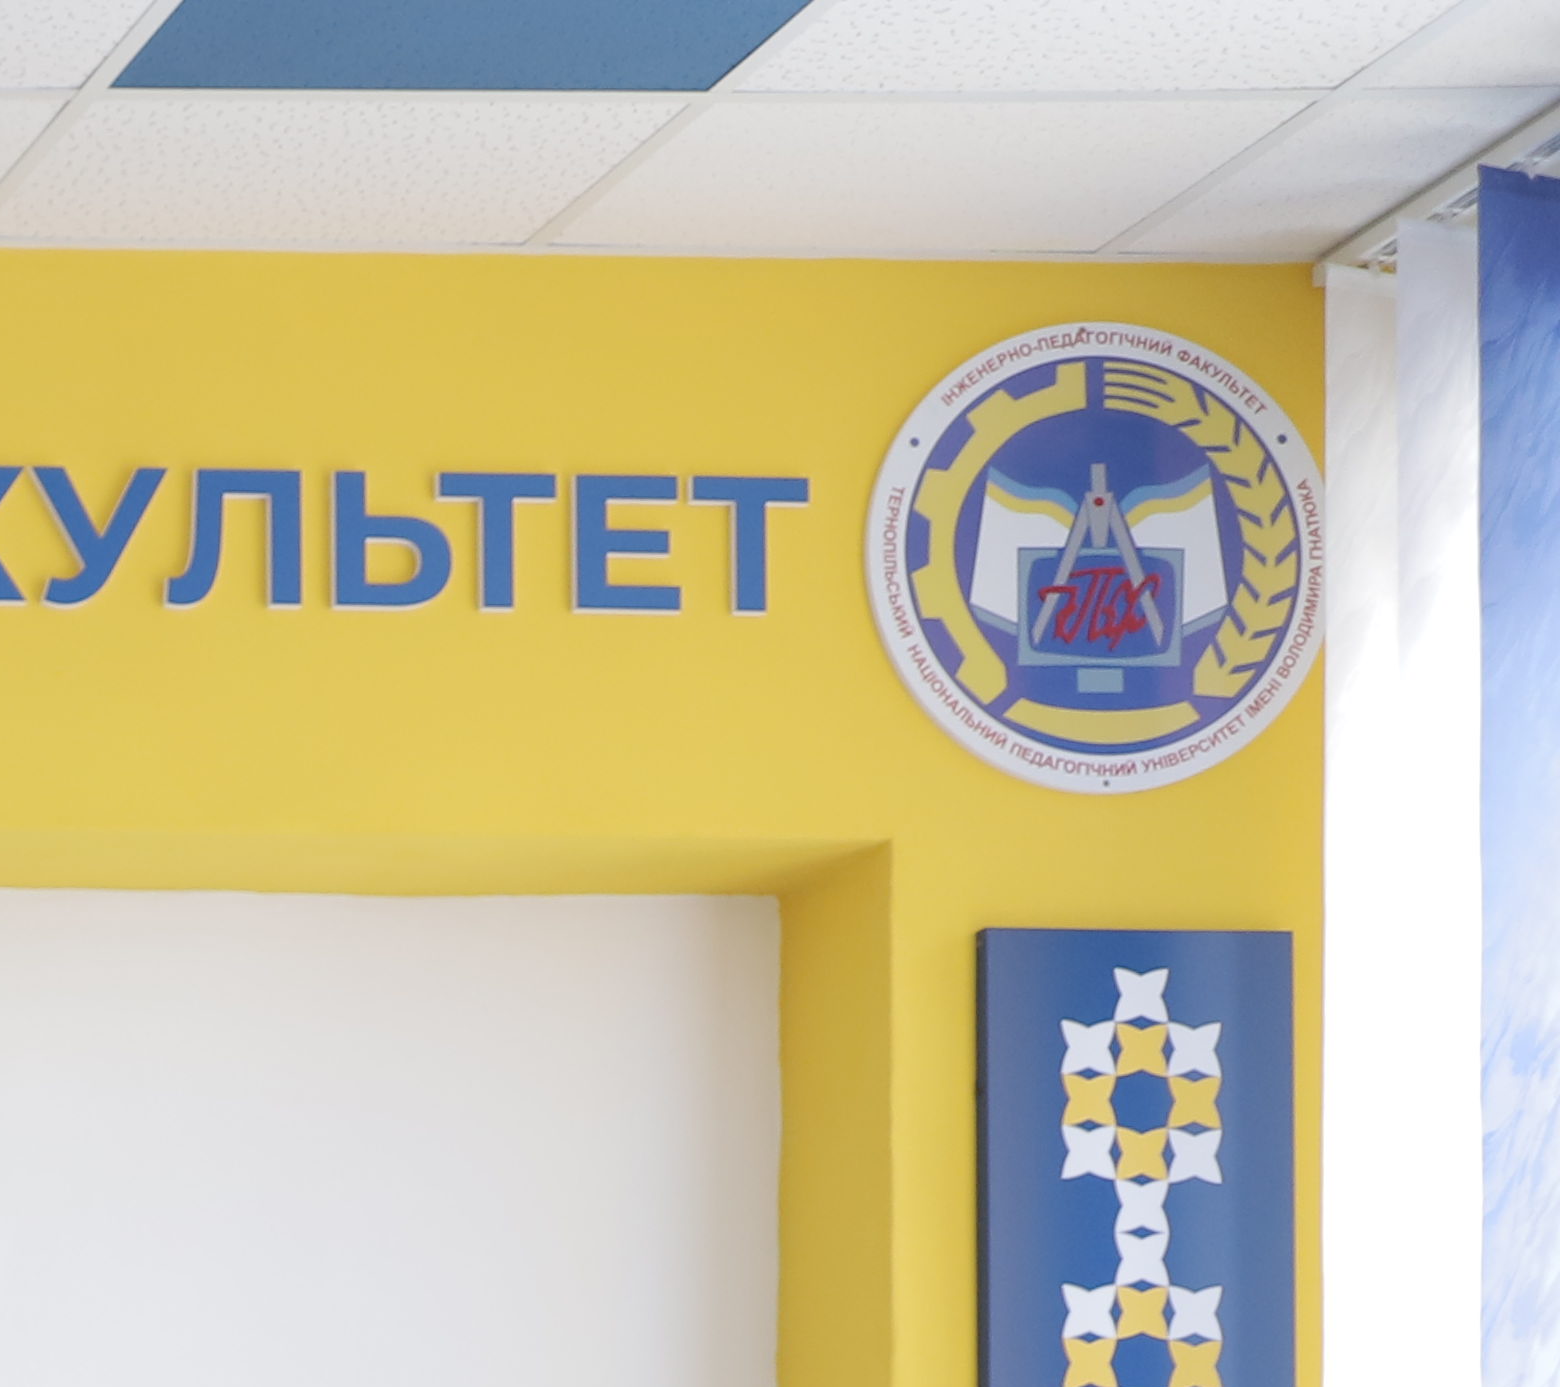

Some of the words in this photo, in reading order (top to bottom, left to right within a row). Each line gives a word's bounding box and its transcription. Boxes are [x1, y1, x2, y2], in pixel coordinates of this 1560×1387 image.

[941, 330, 1172, 406] ІНЖЕНЕРНО-ПЕДАГОГІЧНИЙ
[1177, 350, 1268, 415] ФАКУЛЬТЕТ
[1297, 478, 1321, 561] ГНАТЮКА
[883, 486, 914, 638] ТЕРНОПІЛЬСЬКИЙ
[1277, 567, 1321, 680] ВОЛОДИМИРА
[907, 644, 1007, 750] НАЦІОНАЛЬНИЙ
[1246, 677, 1282, 720] ІМЕНІ
[1010, 742, 1137, 777] ПЕДАГОГІЧНИЙ
[1142, 716, 1246, 773] УНІВЕРСИТЕТ
